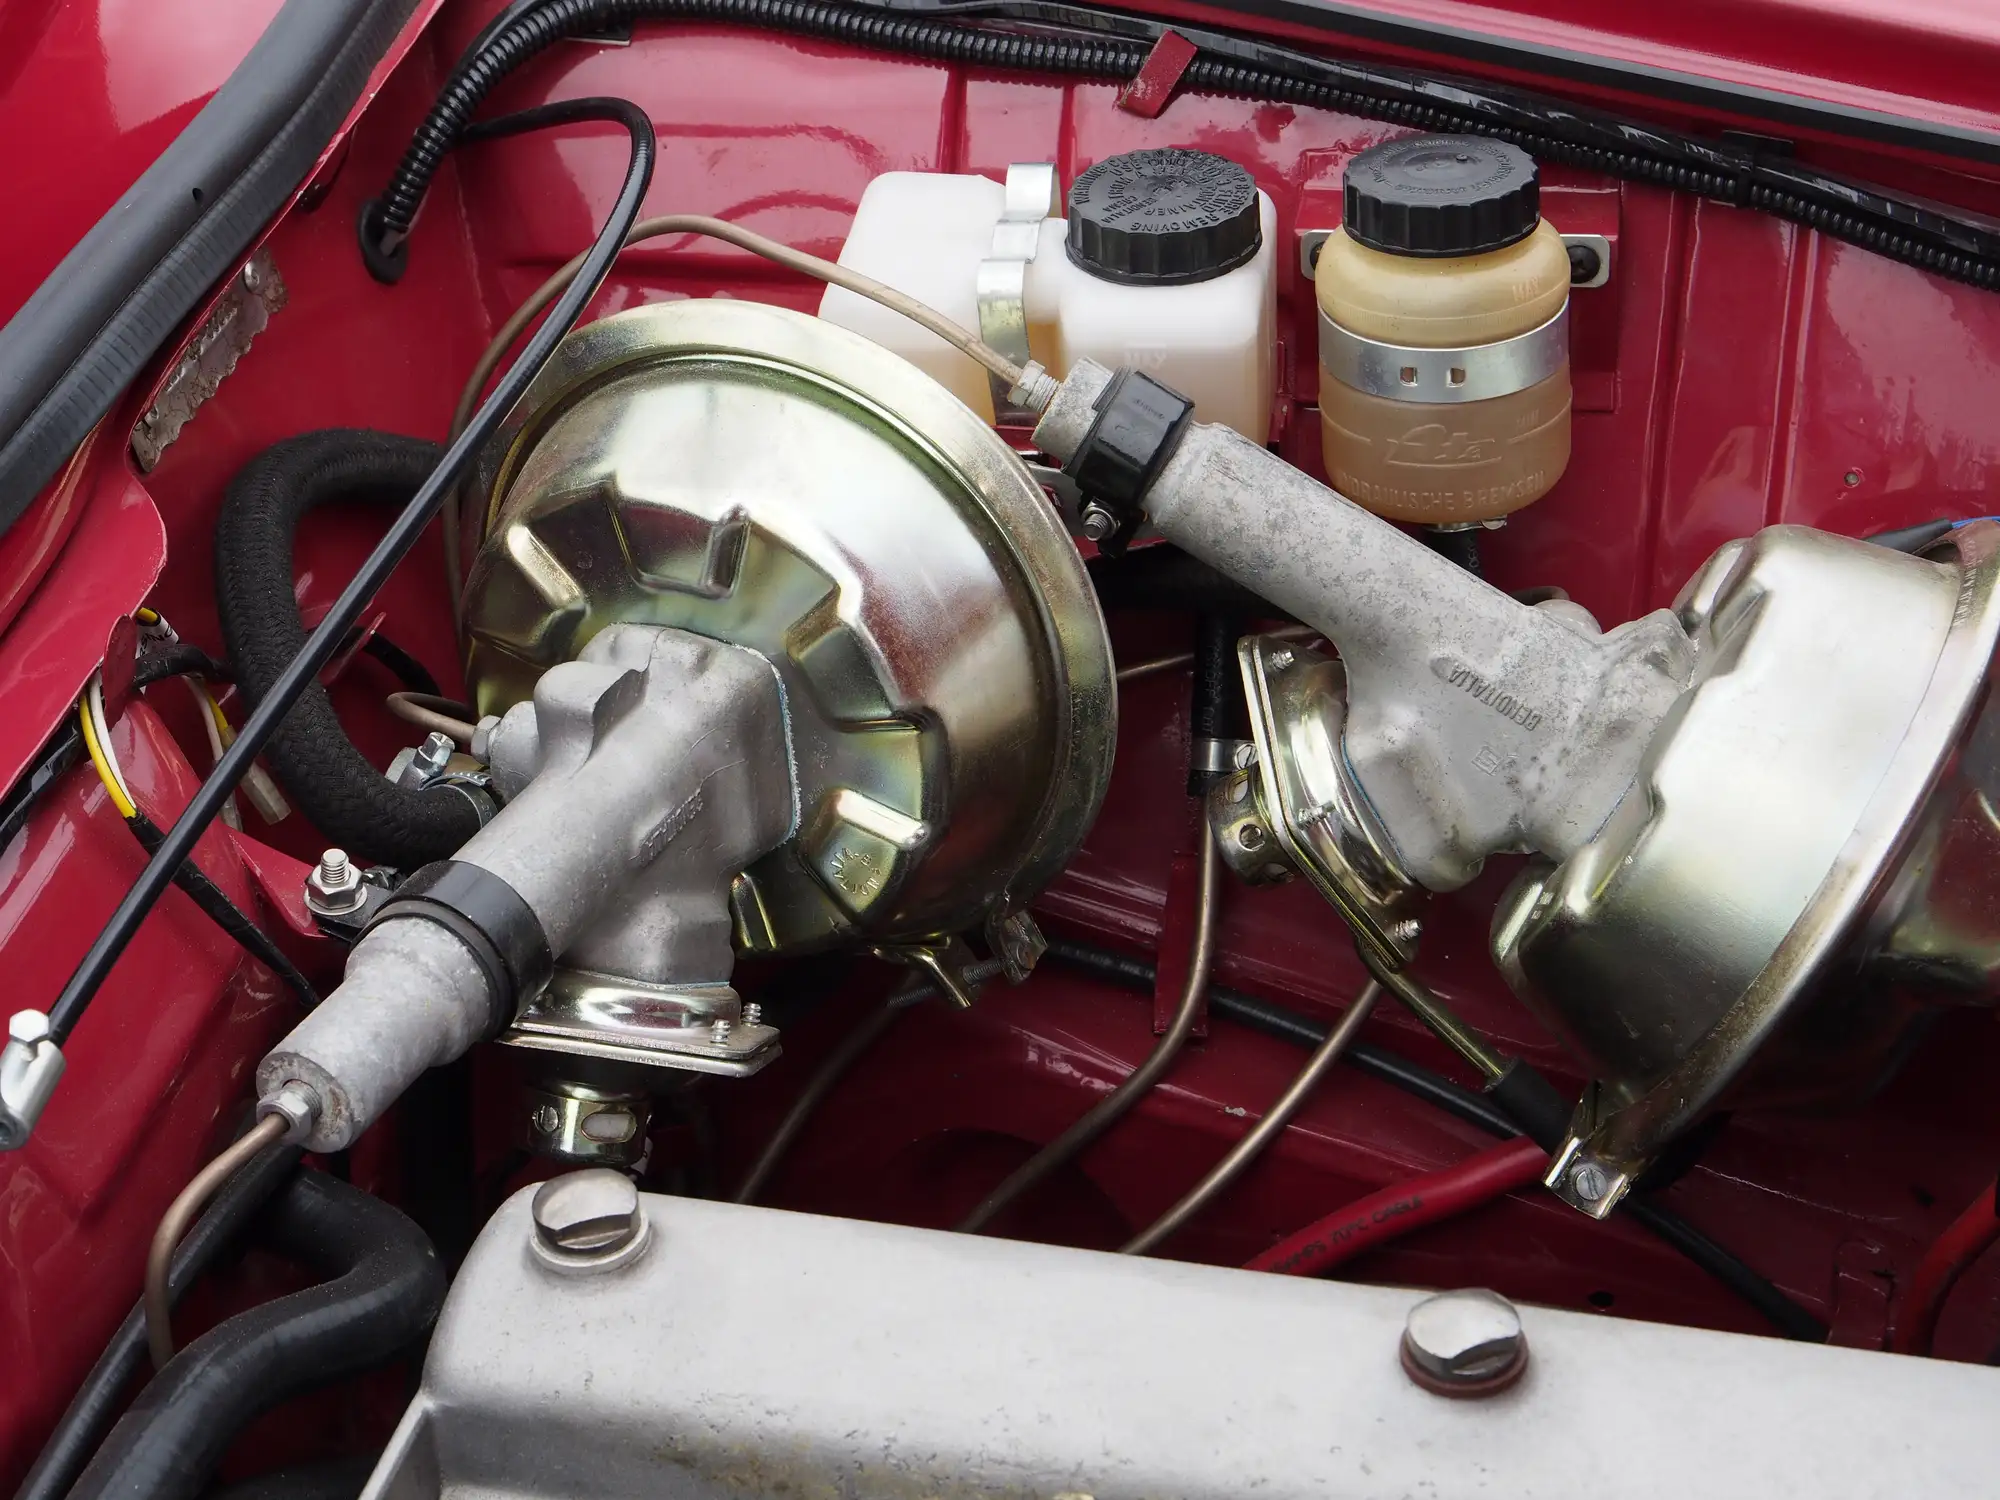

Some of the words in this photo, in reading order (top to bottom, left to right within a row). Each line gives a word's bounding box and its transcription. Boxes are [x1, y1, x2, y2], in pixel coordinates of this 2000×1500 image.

[1107, 150, 1164, 168] CLEAN
[1109, 158, 1143, 177] USE
[1134, 170, 1148, 179] A
[1130, 213, 1220, 232] REMOVING
[1448, 667, 1543, 731] BENDITALIA
